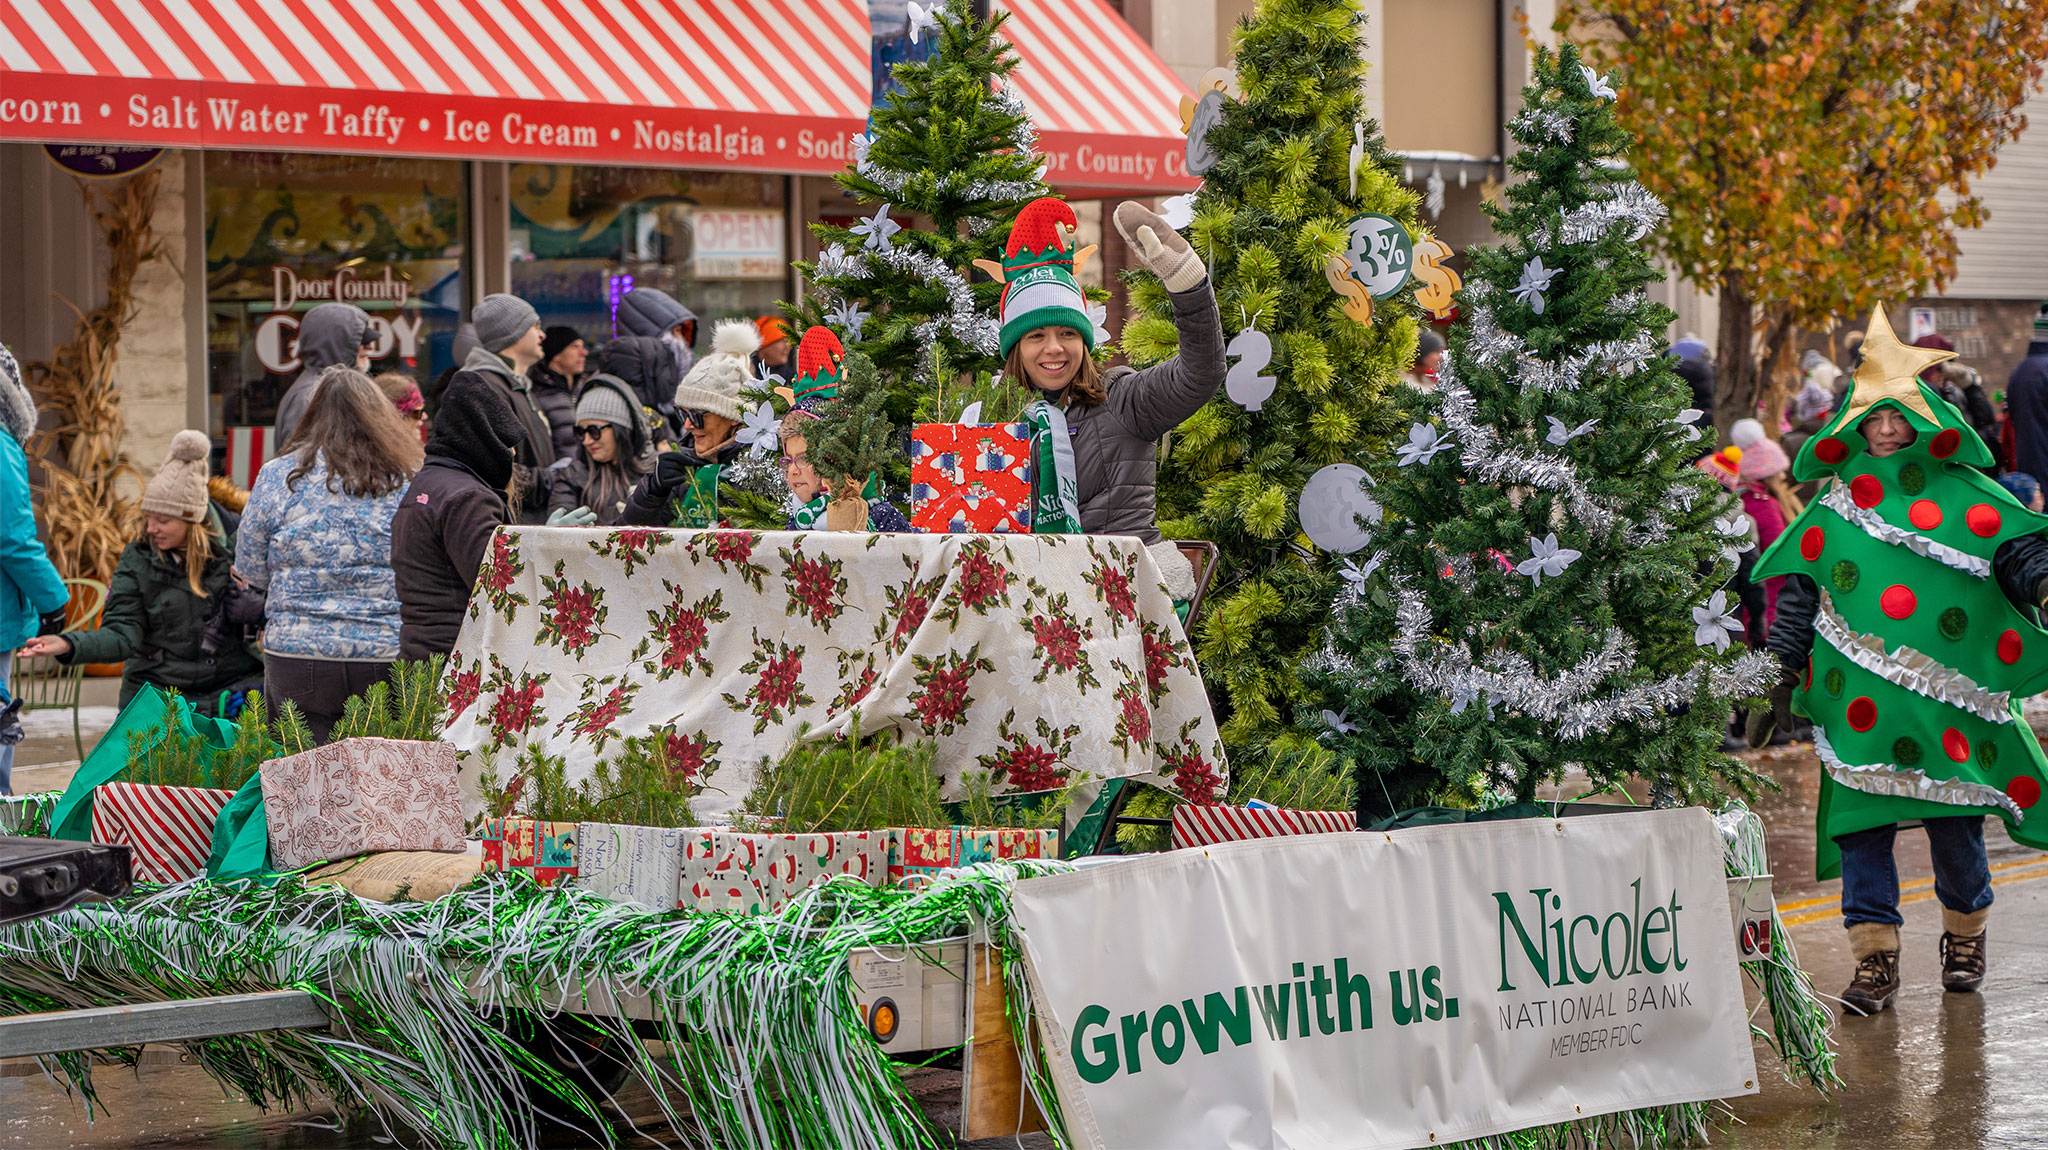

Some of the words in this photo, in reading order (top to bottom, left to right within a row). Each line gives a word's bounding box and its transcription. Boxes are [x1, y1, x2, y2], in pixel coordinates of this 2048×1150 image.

[0, 98, 82, 125] corn
[128, 94, 199, 130] Salt
[207, 97, 309, 134] Water
[319, 103, 405, 145] Taffy
[443, 109, 491, 143] Ice
[501, 112, 599, 148] Cream
[632, 119, 766, 161] Nostalgia
[1076, 144, 1158, 181] County
[697, 213, 776, 249] OPEN
[271, 265, 334, 313] Door
[333, 265, 409, 308] County
[255, 313, 424, 376] CDY
[594, 839, 606, 870] Noel
[1491, 876, 1688, 992] Nicolet
[1070, 985, 1252, 1085] Grow
[1250, 957, 1374, 1042] with
[1388, 964, 1460, 1027] us.
[1499, 991, 1617, 1031] NATIONAL
[1626, 981, 1692, 1012] BANK
[1550, 1028, 1609, 1059] MEMBER
[1610, 1022, 1642, 1049] FDIC
